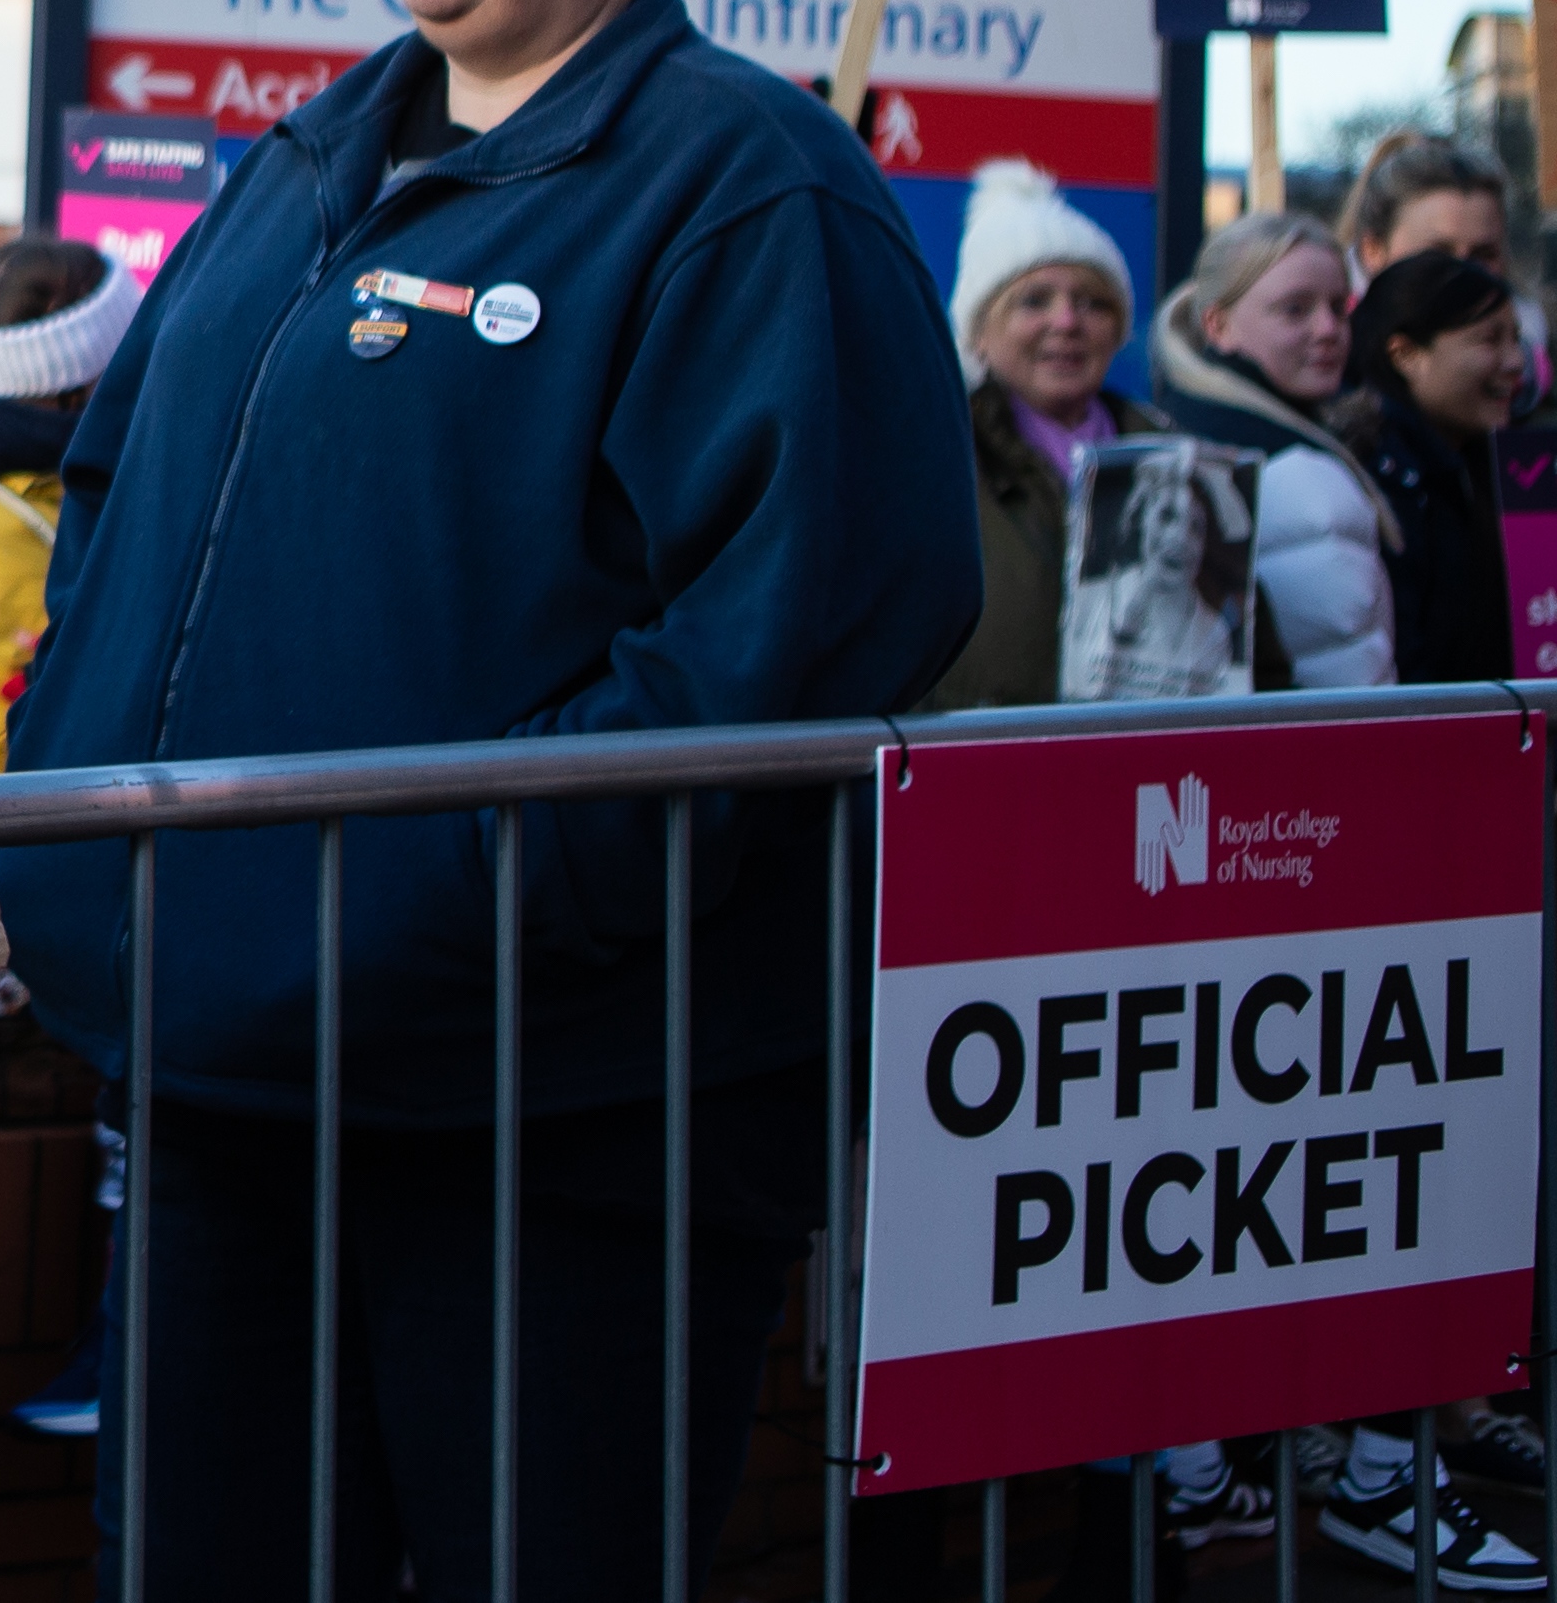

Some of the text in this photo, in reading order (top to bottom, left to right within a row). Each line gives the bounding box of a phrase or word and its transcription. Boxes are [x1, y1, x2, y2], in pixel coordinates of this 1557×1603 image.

[1217, 849, 1314, 888] of Nursing
[1219, 808, 1340, 853] Royal College
[925, 957, 1505, 1139] OFFICIAL
[991, 1121, 1445, 1307] PICKET
